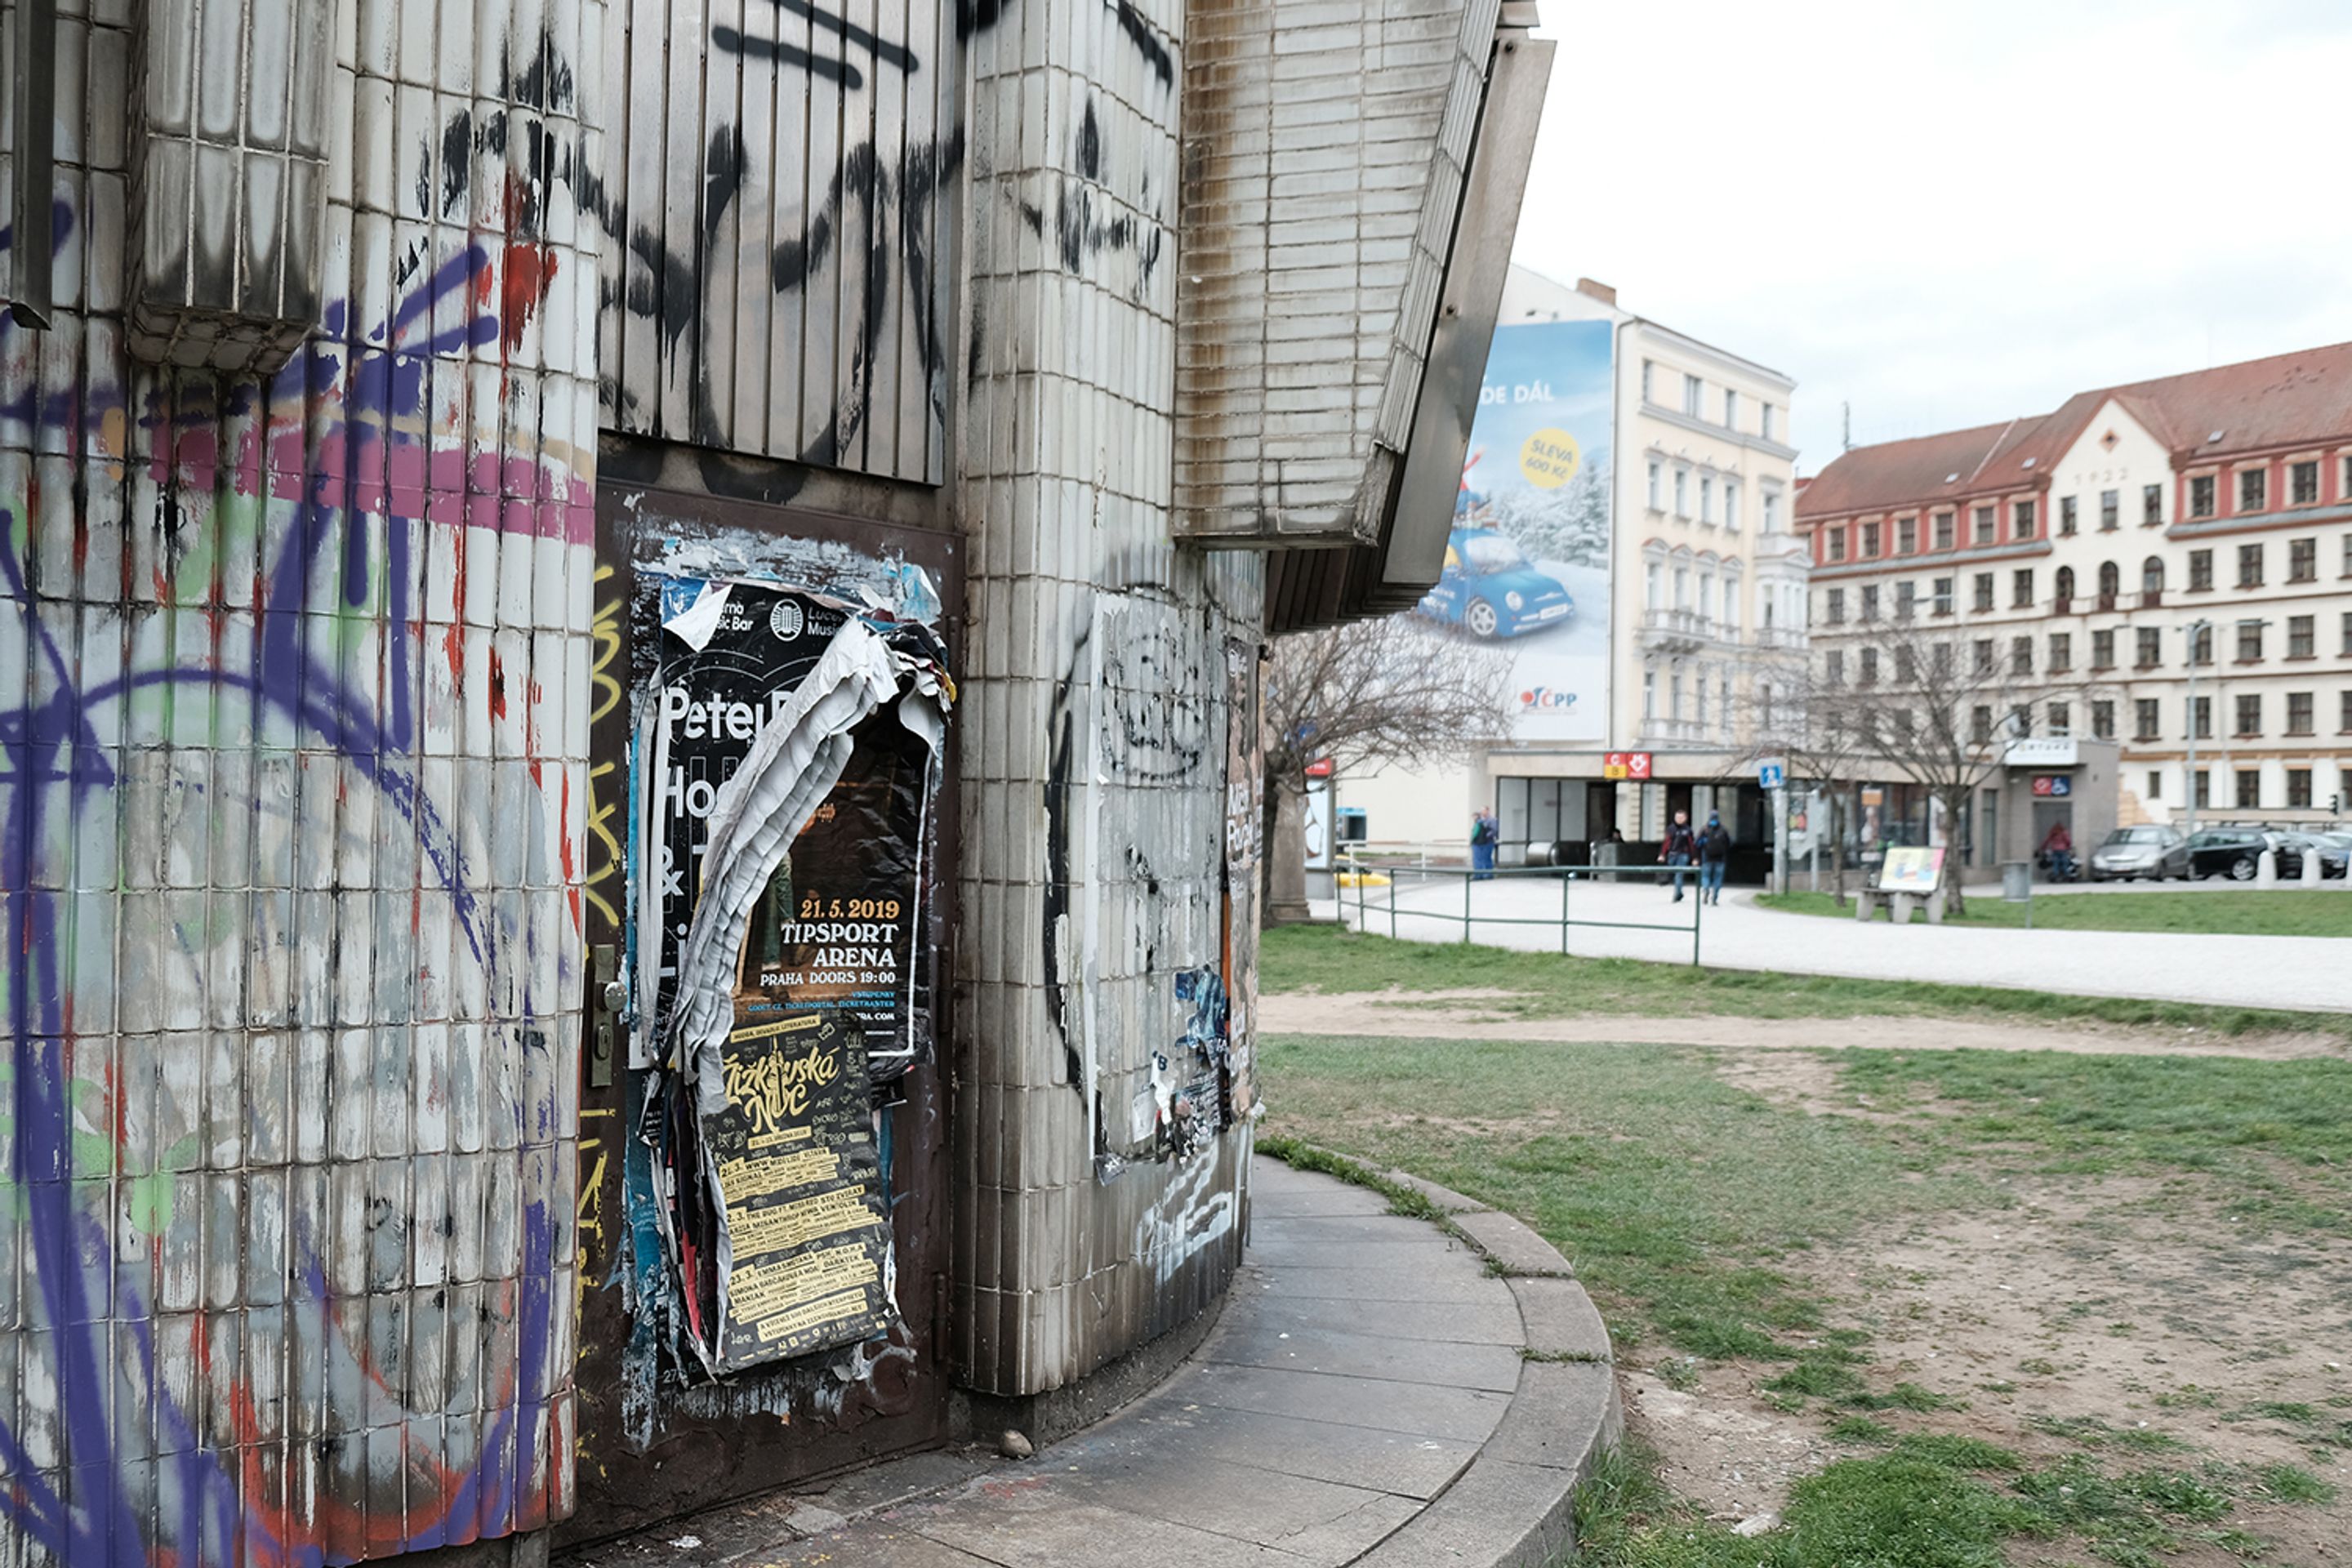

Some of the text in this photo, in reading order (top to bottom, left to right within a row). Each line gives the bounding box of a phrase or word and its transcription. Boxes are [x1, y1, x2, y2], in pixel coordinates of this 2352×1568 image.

[1514, 379, 1555, 403] DÁL
[1530, 439, 1574, 464] SLEVA
[1526, 456, 1550, 473] 600
[732, 617, 754, 632] Bar
[800, 898, 900, 920] 21. 5. 2019
[781, 923, 899, 943] TIPSPORT
[812, 947, 897, 968] ARENA
[760, 971, 896, 987] PRAHA DOORS 19:00
